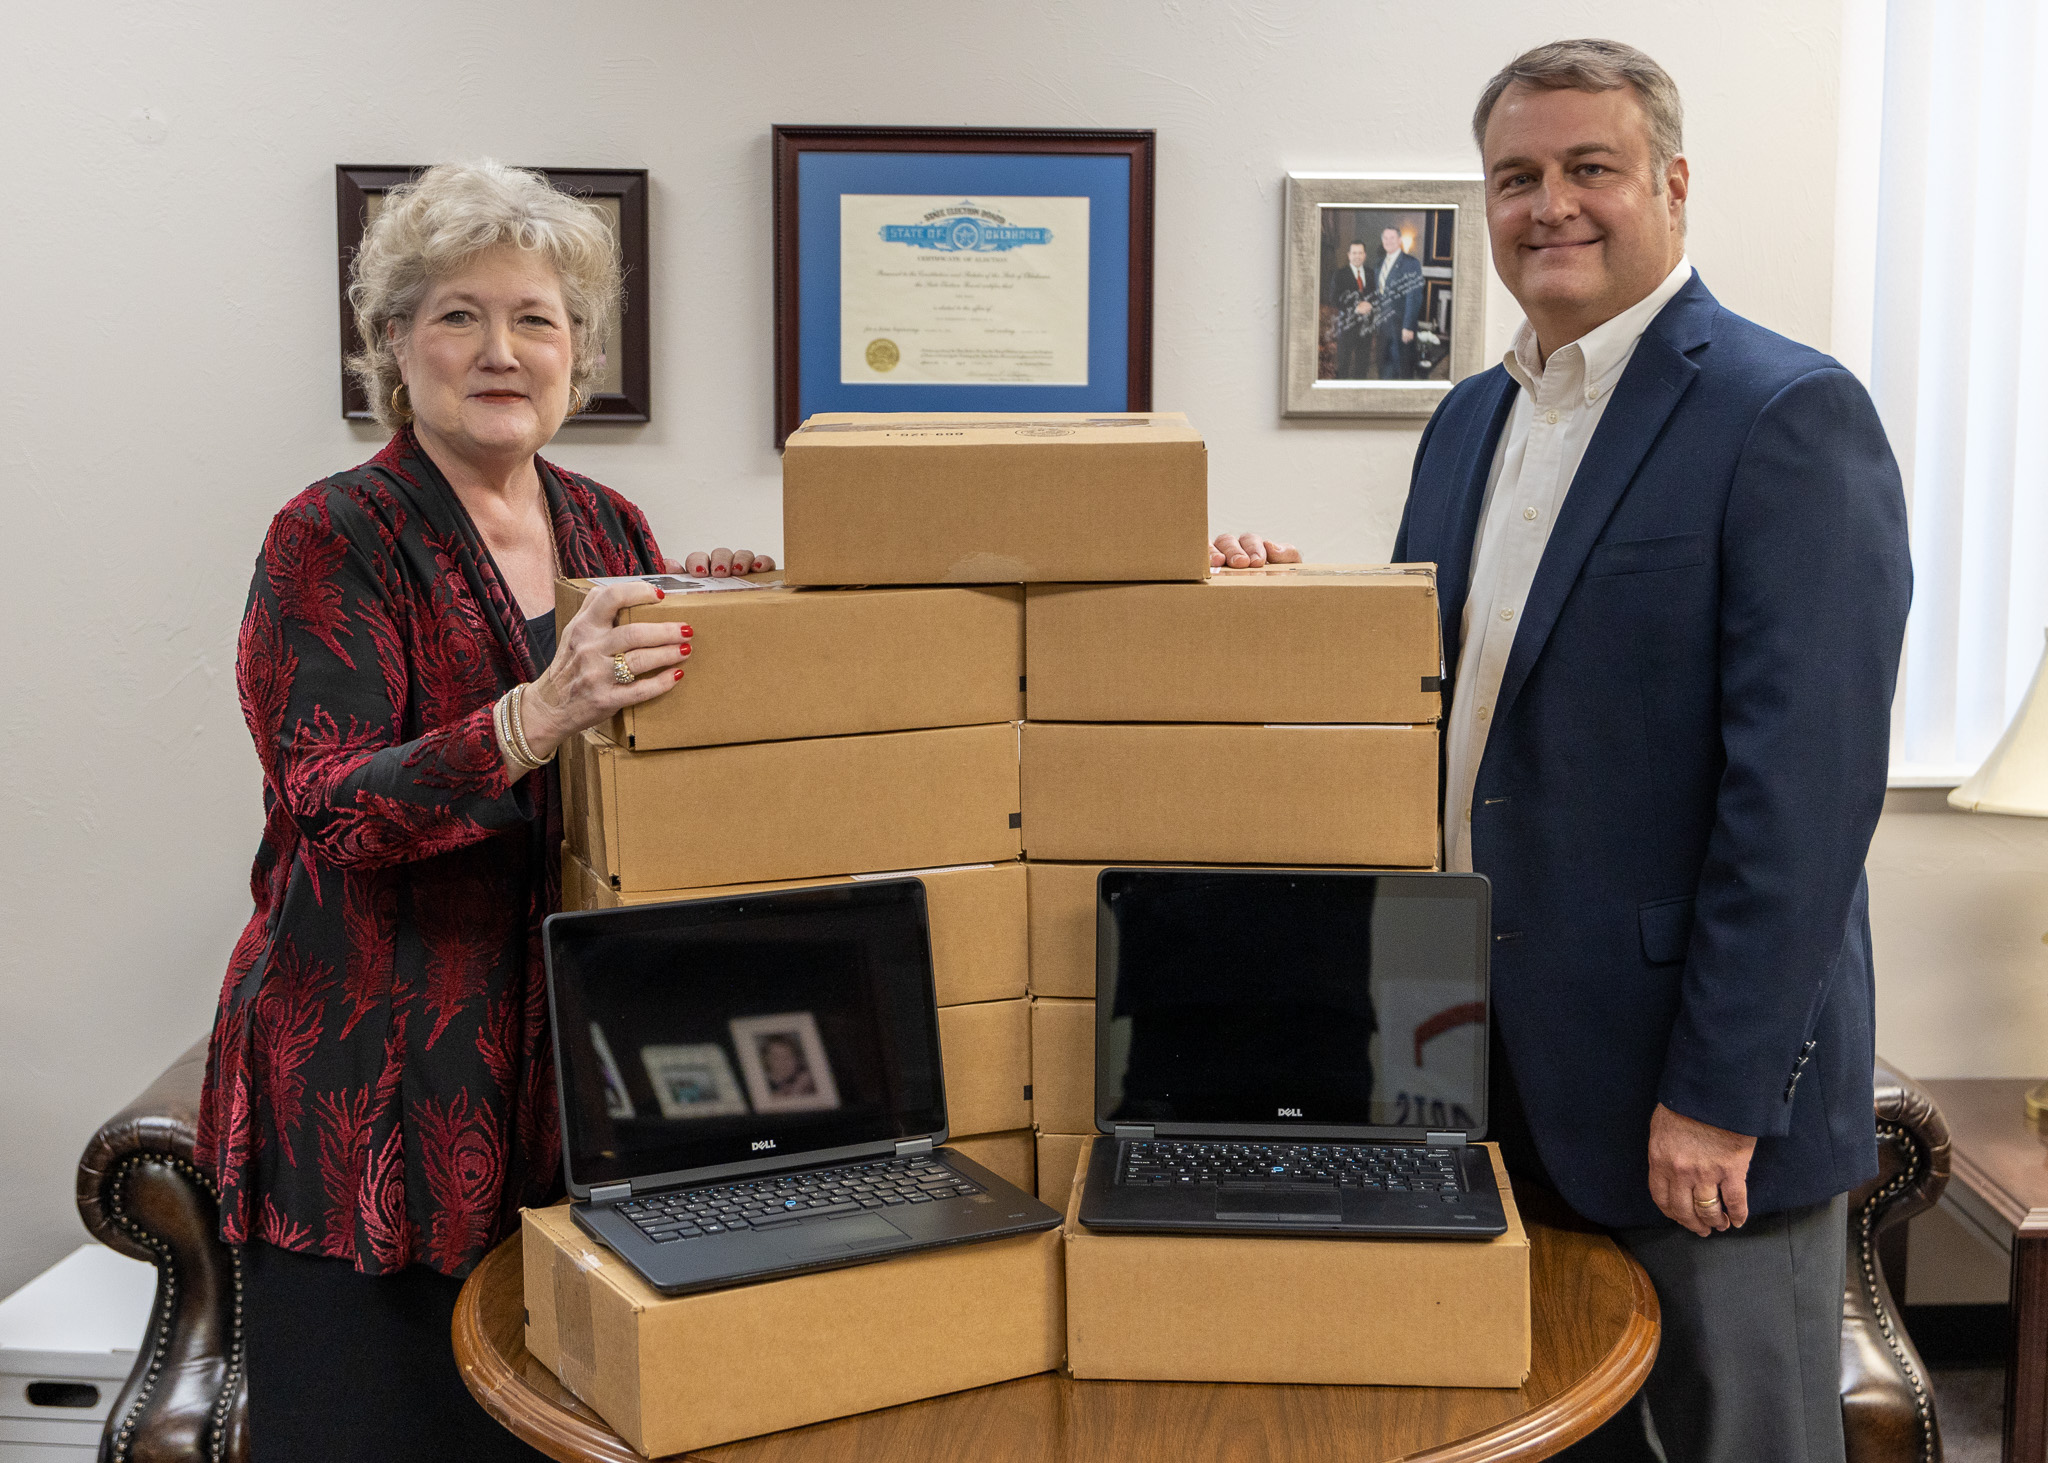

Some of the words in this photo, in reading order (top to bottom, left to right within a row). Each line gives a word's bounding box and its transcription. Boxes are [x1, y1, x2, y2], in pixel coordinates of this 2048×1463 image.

[890, 228, 924, 239] STATE
[927, 228, 943, 240] OF
[985, 229, 1041, 240] OKLAHOMA
[1277, 1107, 1303, 1117] DELL
[751, 1139, 777, 1151] DELL
